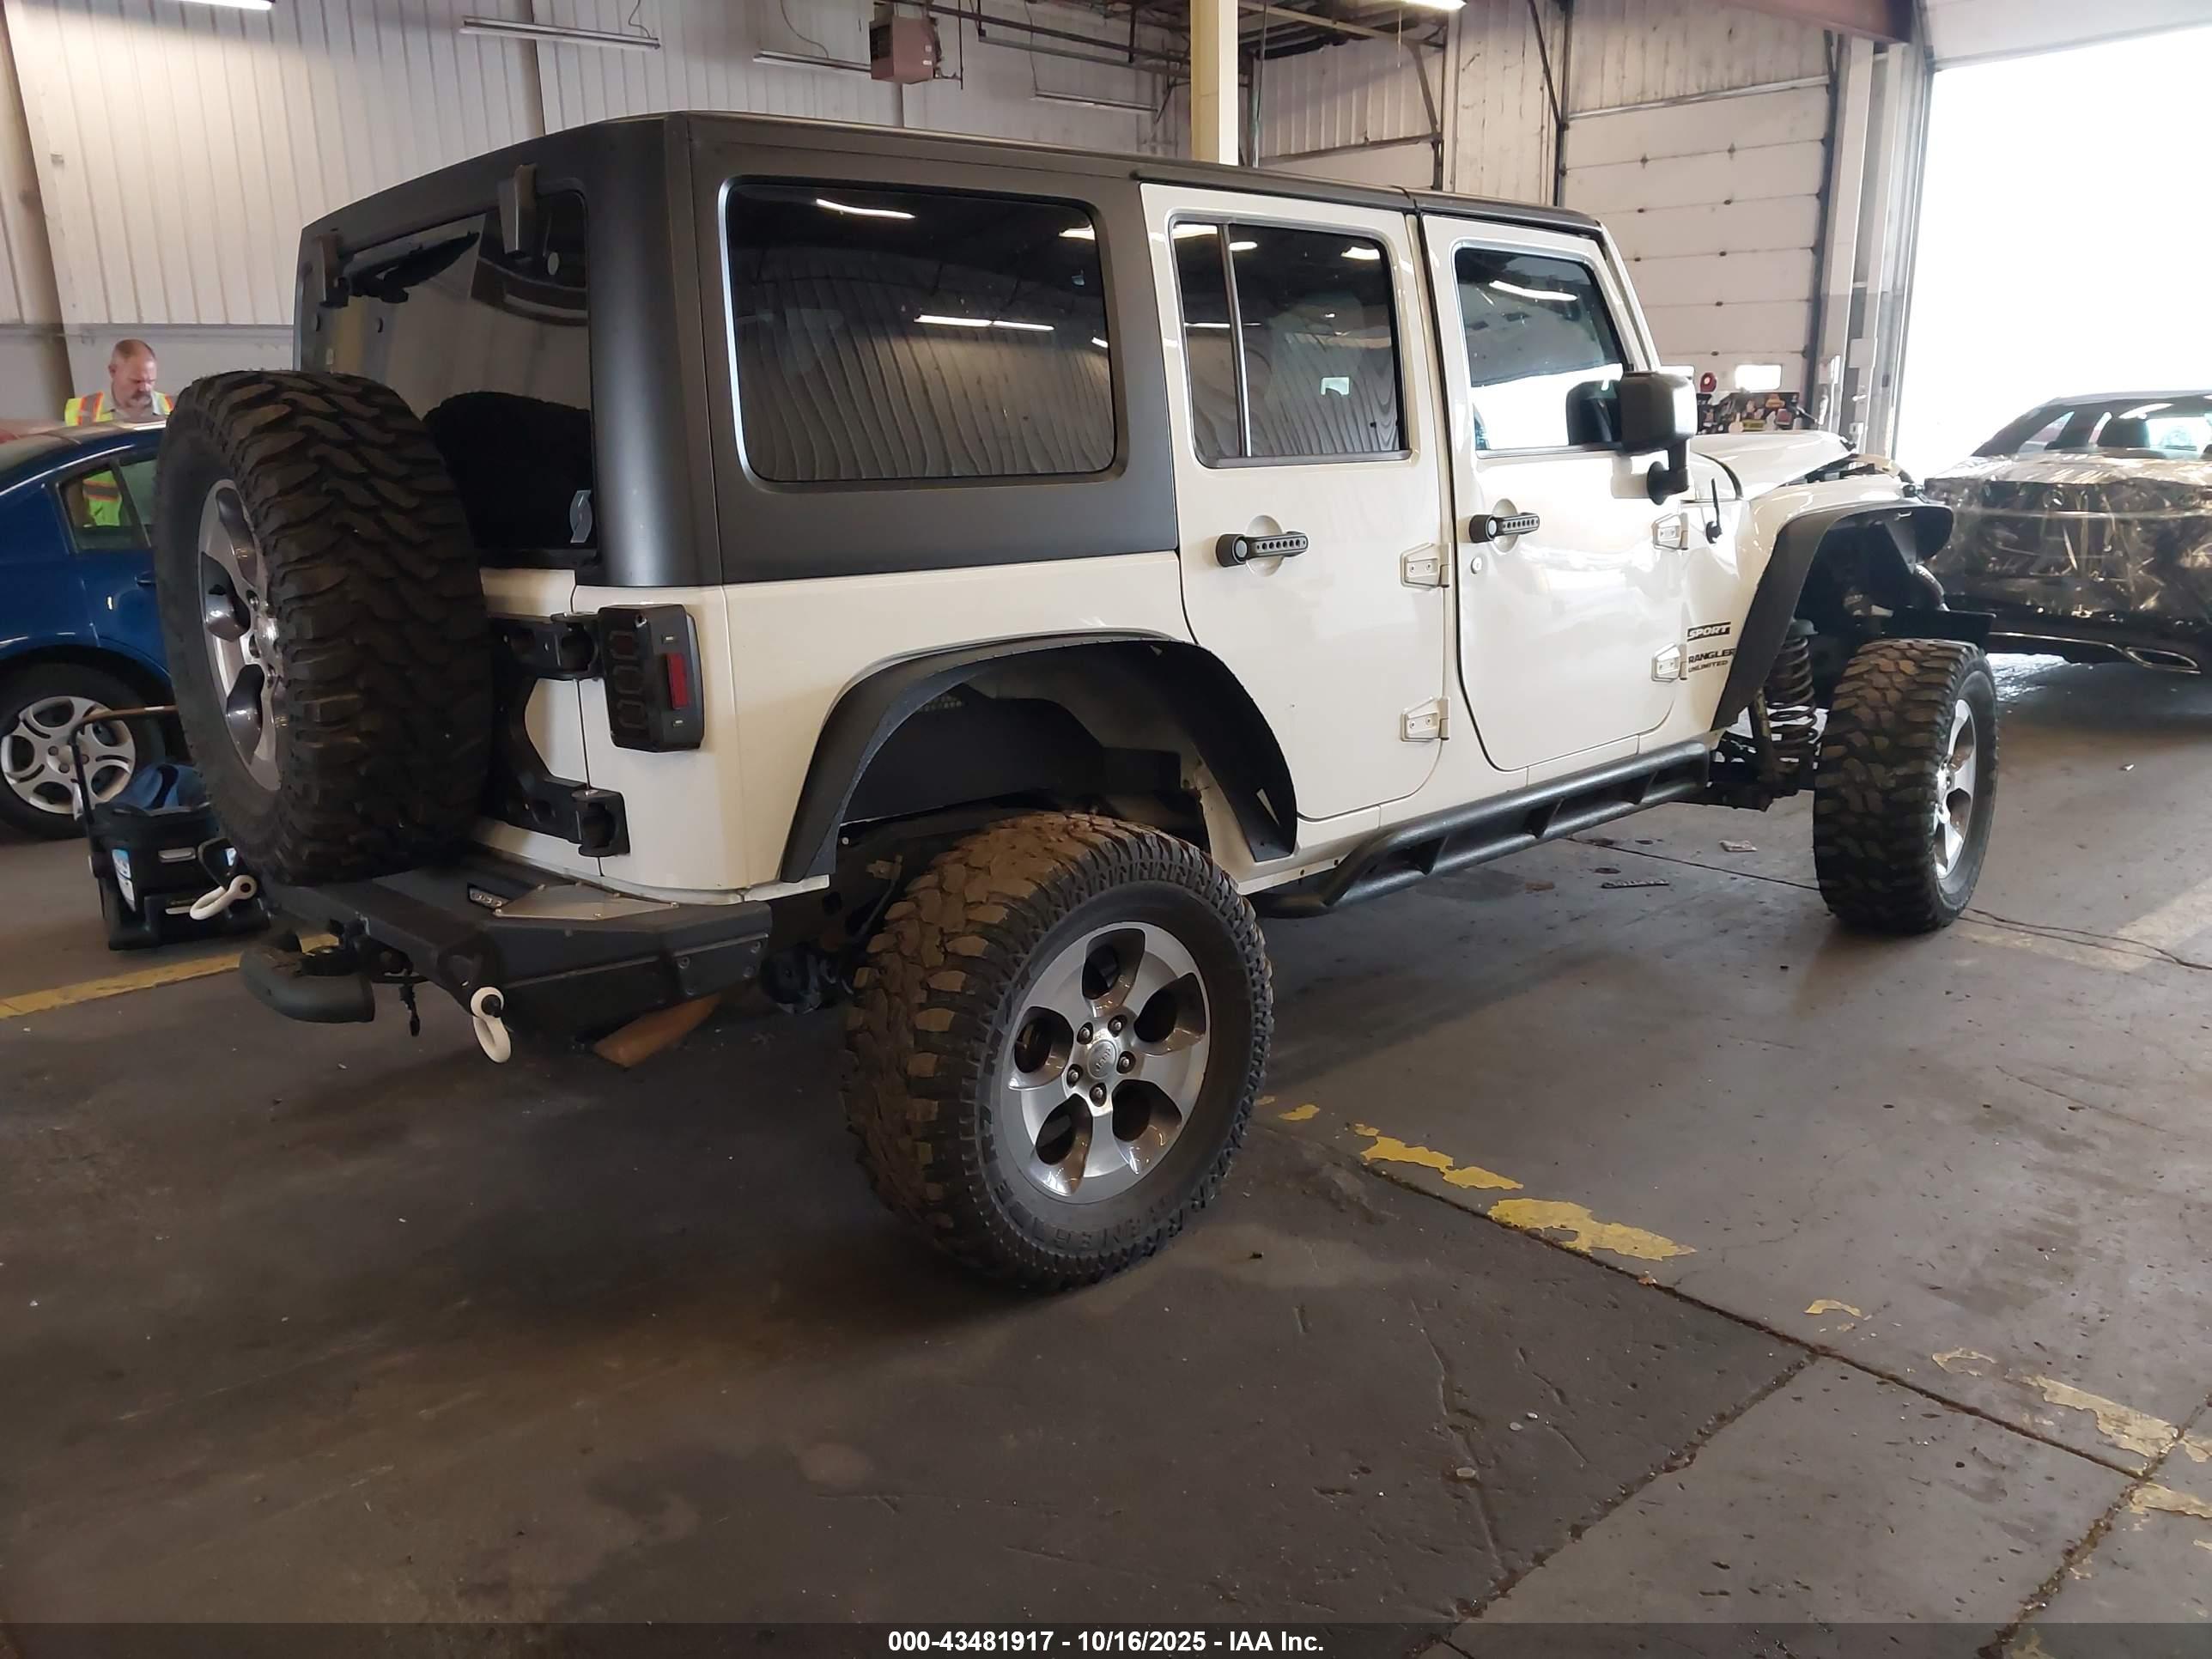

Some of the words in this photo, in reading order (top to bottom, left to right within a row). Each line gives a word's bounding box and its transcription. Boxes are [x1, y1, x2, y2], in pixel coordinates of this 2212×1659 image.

[1687, 623, 1729, 640] SPORT
[1688, 659, 1729, 673] UNLIMITED
[1095, 1045, 1113, 1073] Jeep
